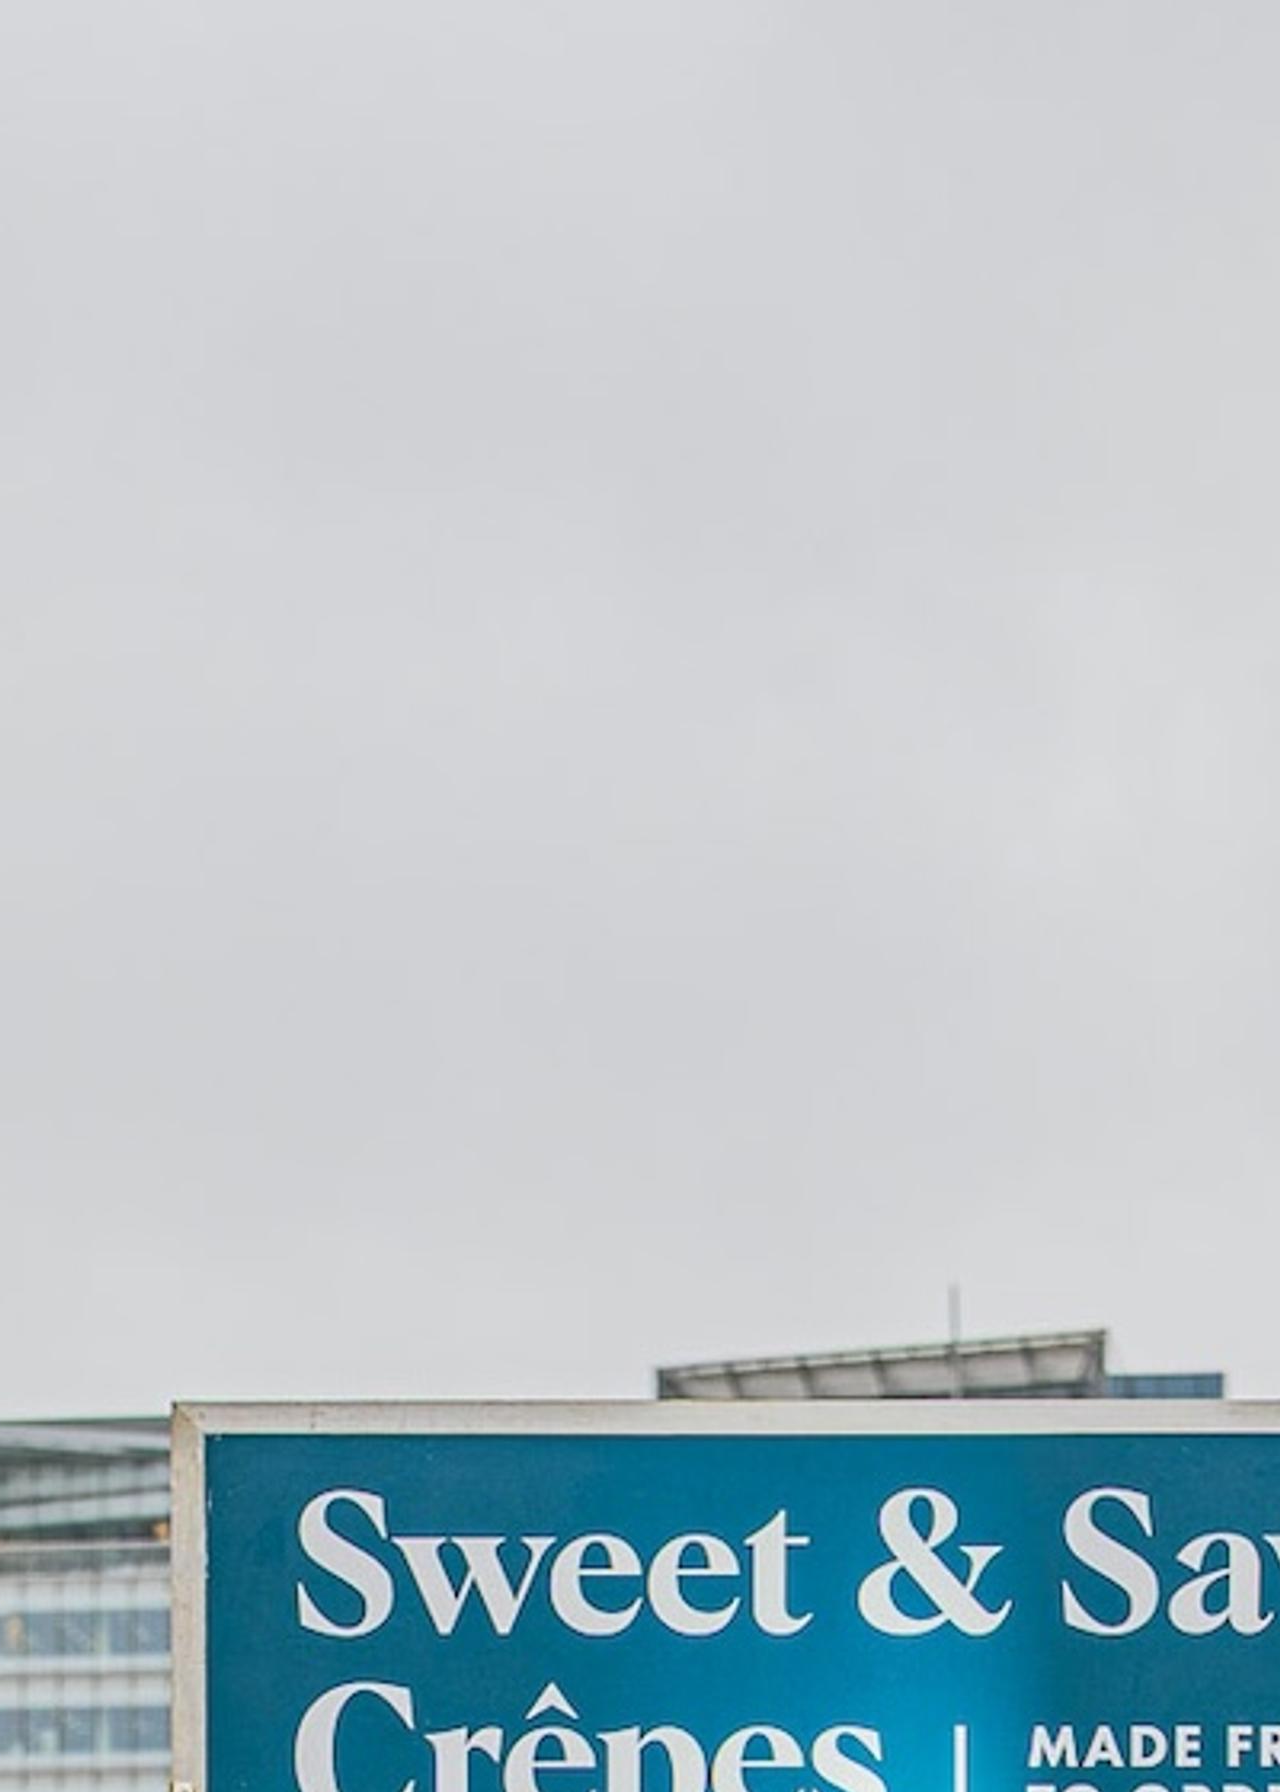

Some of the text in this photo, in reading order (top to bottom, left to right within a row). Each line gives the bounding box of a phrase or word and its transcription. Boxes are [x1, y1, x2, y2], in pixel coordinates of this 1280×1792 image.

[298, 1489, 813, 1637] Sweet
[858, 1488, 1012, 1636] &
[1029, 1725, 1201, 1767] MADE
